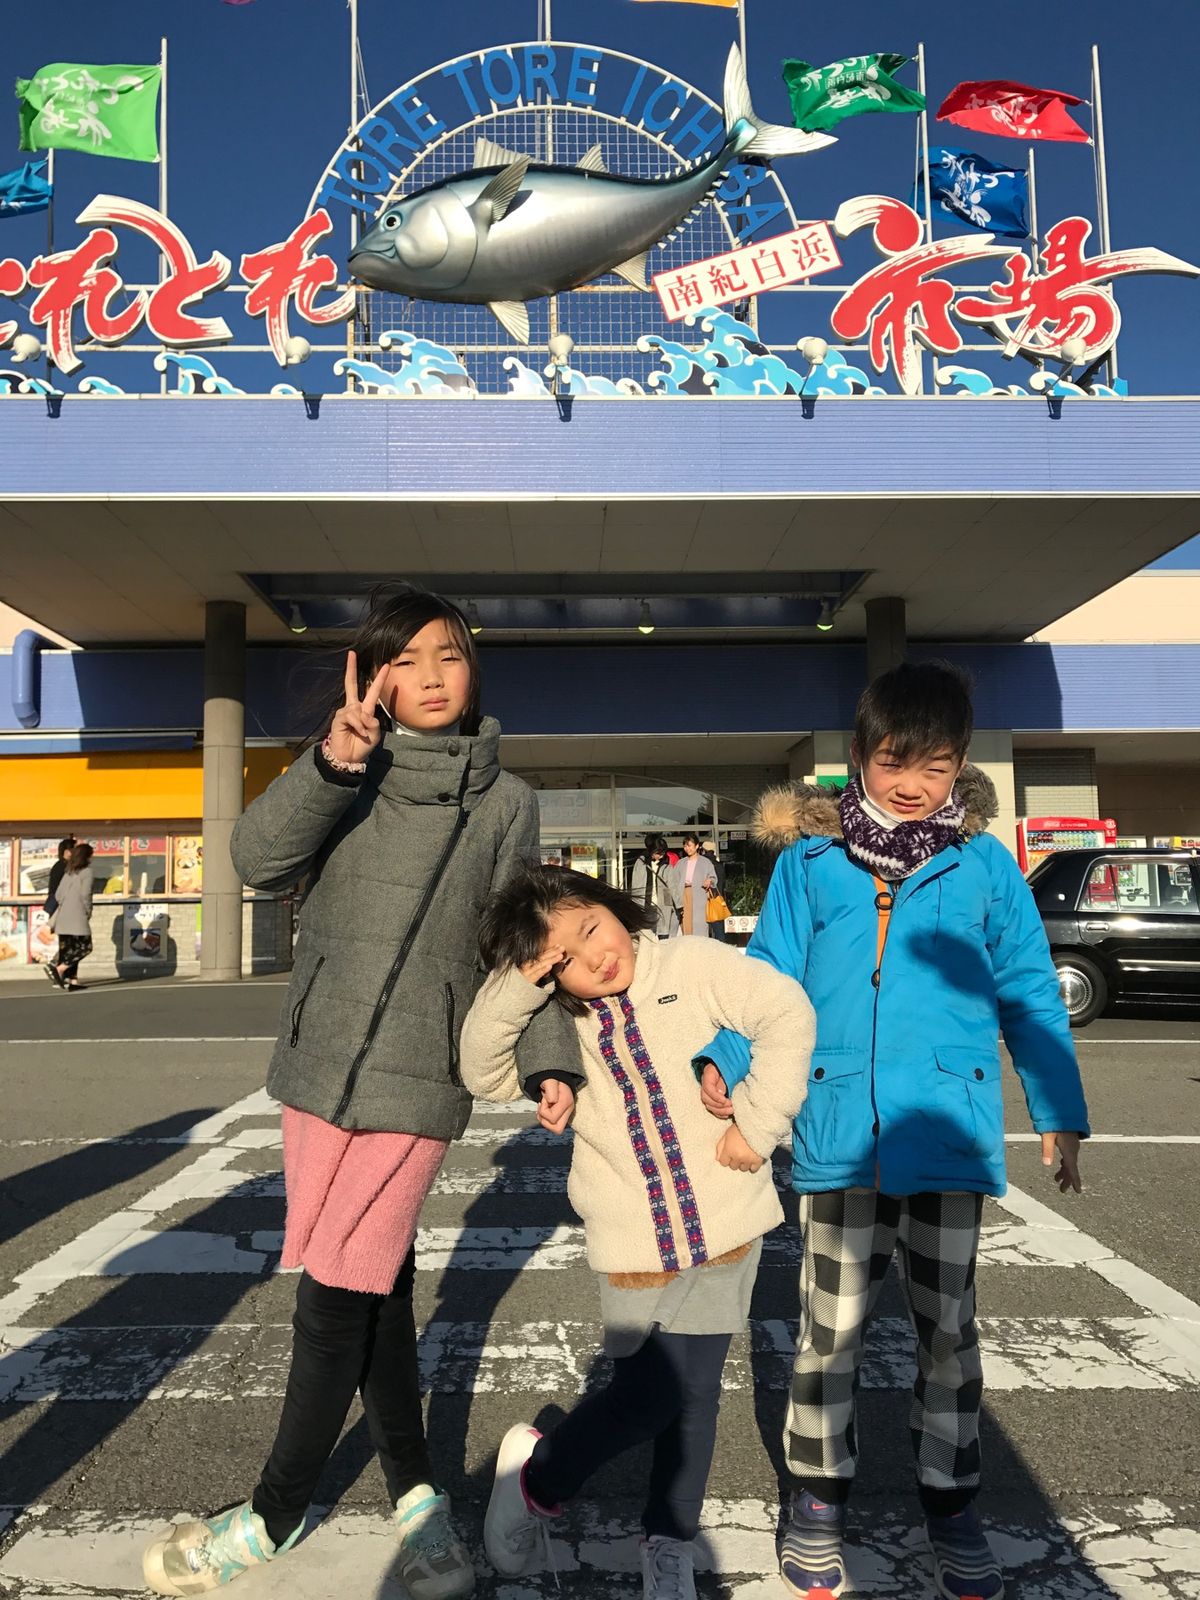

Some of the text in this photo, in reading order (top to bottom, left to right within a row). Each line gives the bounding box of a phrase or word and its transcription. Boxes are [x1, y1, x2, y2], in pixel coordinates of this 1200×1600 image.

[316, 45, 786, 241] TORE TORE ICHBA
[663, 231, 832, 312] 南紀白浜
[830, 194, 1200, 396] 市場
